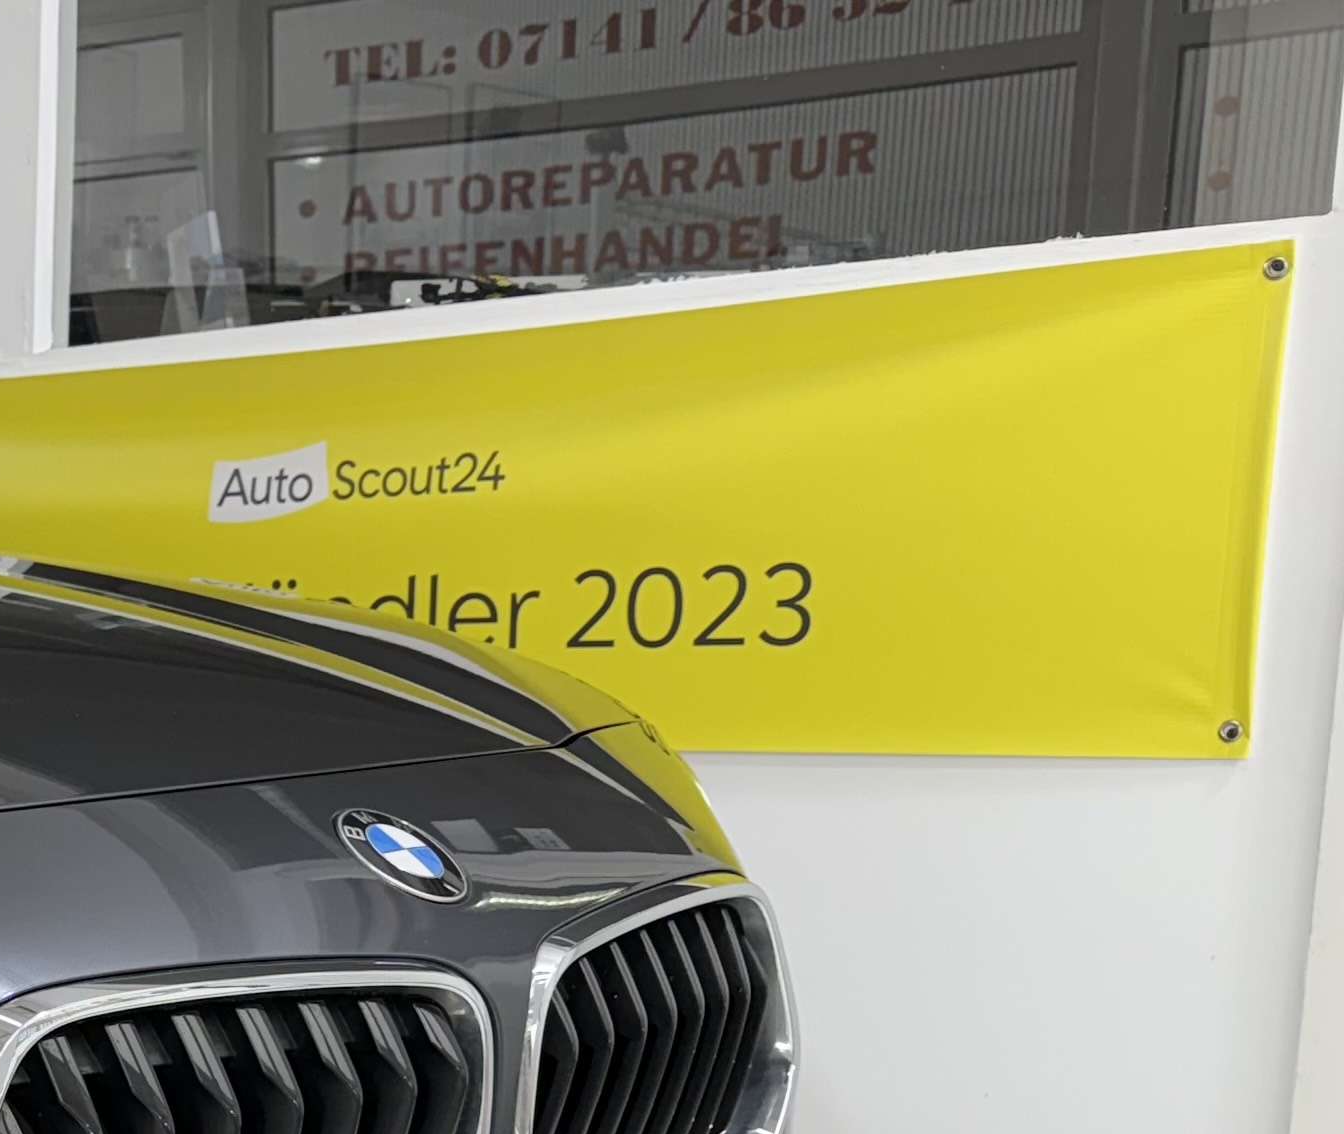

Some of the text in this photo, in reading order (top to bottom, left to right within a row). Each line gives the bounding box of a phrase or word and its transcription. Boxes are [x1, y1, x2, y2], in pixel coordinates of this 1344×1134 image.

[323, 39, 457, 87] TEL:
[477, 8, 658, 70] 07141
[342, 130, 879, 227] AUTOREPARATUR
[216, 450, 507, 507] Auto Scout24
[565, 561, 813, 649] 2023
